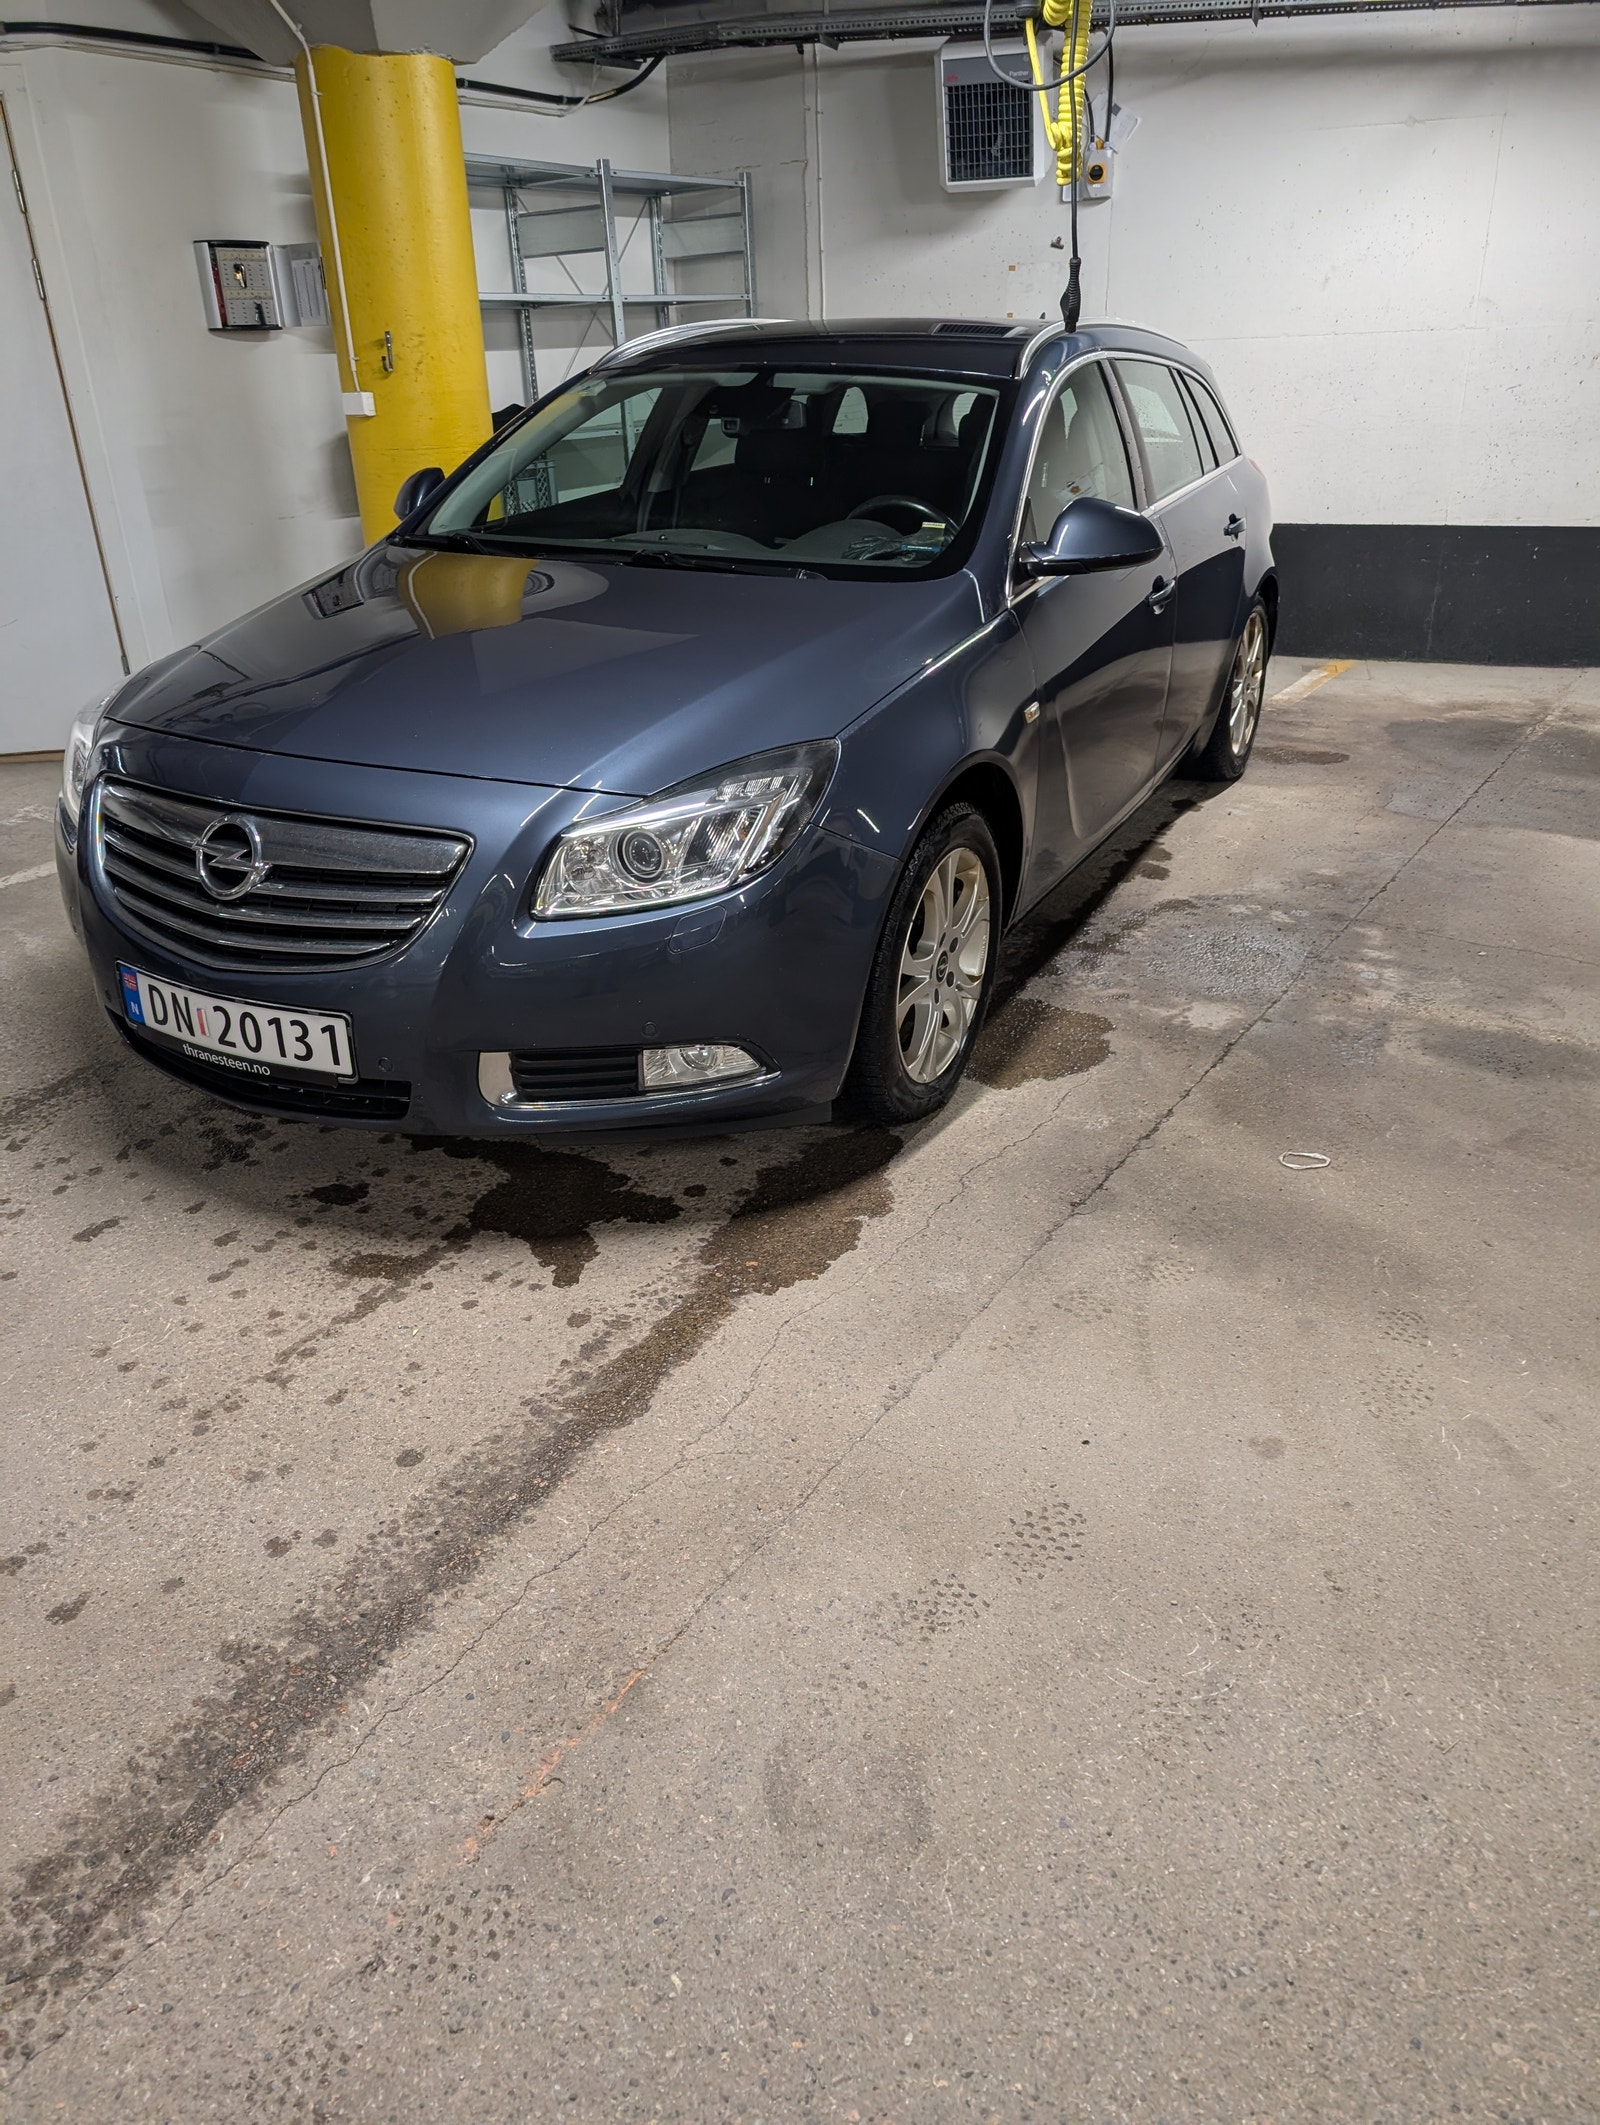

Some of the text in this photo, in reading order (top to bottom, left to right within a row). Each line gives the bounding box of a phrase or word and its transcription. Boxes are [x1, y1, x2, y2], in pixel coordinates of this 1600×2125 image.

[131, 1002, 140, 1016] N
[147, 983, 341, 1066] DN 20131
[182, 1043, 271, 1077] thranesteen.no
